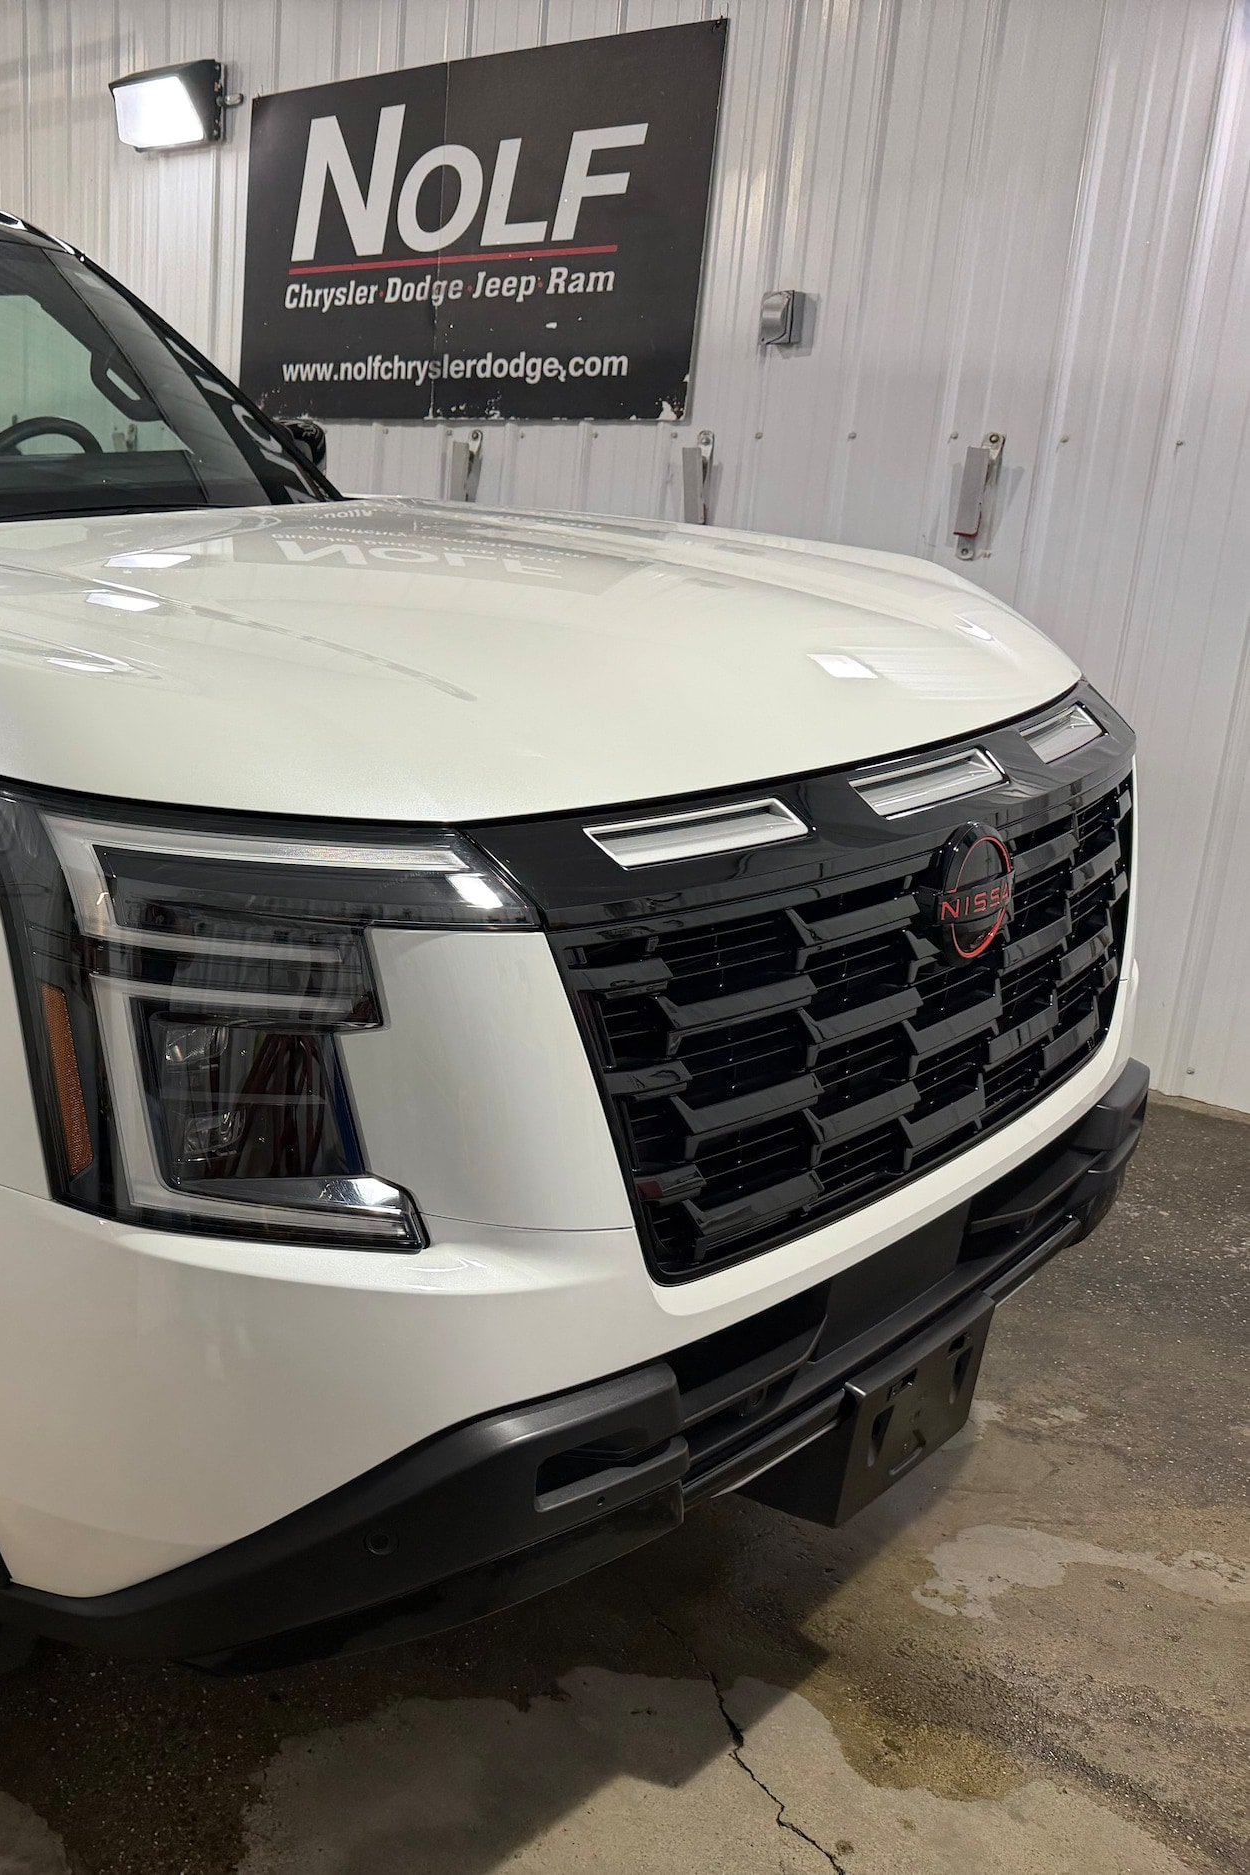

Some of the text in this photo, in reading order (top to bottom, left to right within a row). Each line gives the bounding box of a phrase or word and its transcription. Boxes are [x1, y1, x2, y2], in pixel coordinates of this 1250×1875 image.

[291, 104, 648, 262] NOLF
[284, 267, 615, 312] Chrysler Dodge Jeep Ram
[282, 351, 629, 385] www.nolfchryslerdodge.com
[941, 880, 1011, 920] NISSA
